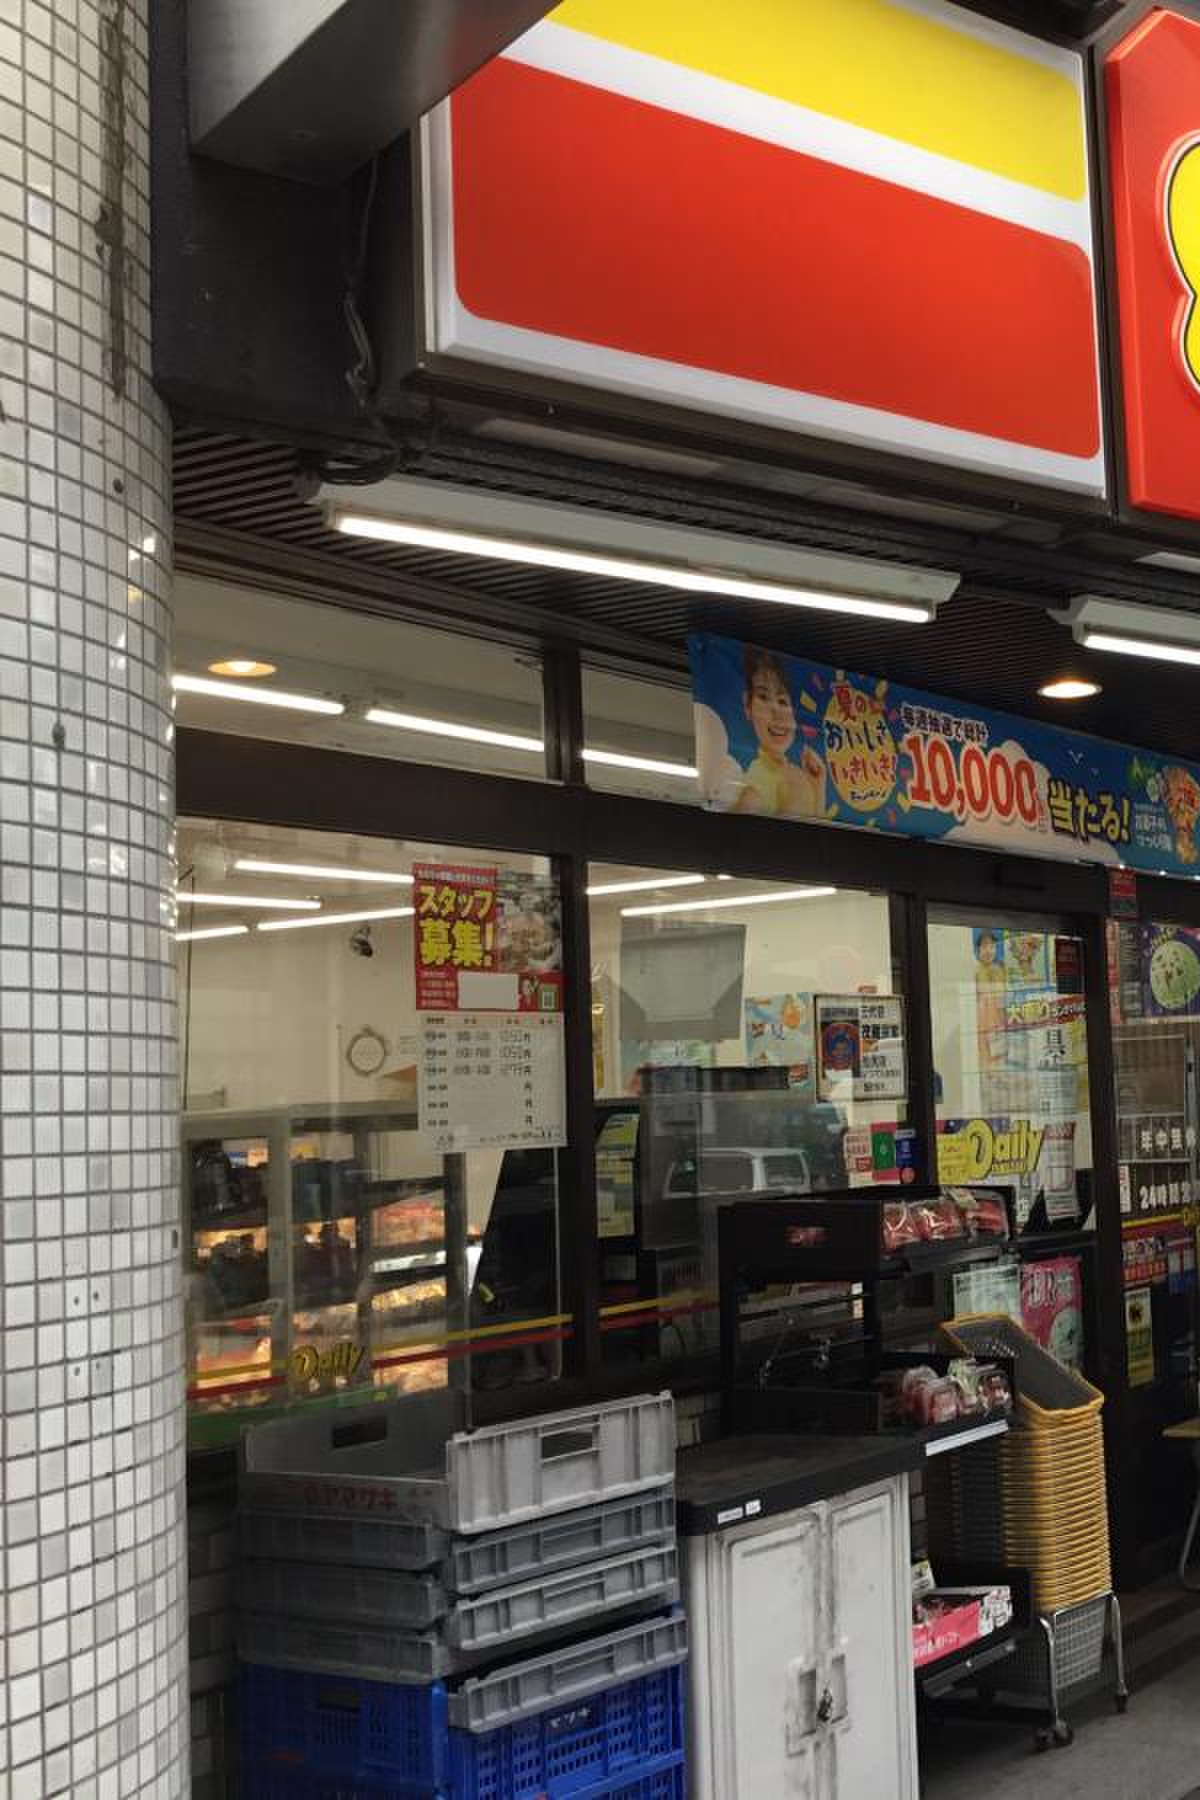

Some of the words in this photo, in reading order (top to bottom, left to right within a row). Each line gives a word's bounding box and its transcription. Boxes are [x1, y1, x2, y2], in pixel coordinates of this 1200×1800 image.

[906, 735, 1039, 824] 10,000
[1048, 778, 1132, 842] 当たる!
[418, 885, 494, 919] スタッフ
[418, 917, 494, 967] 募集!
